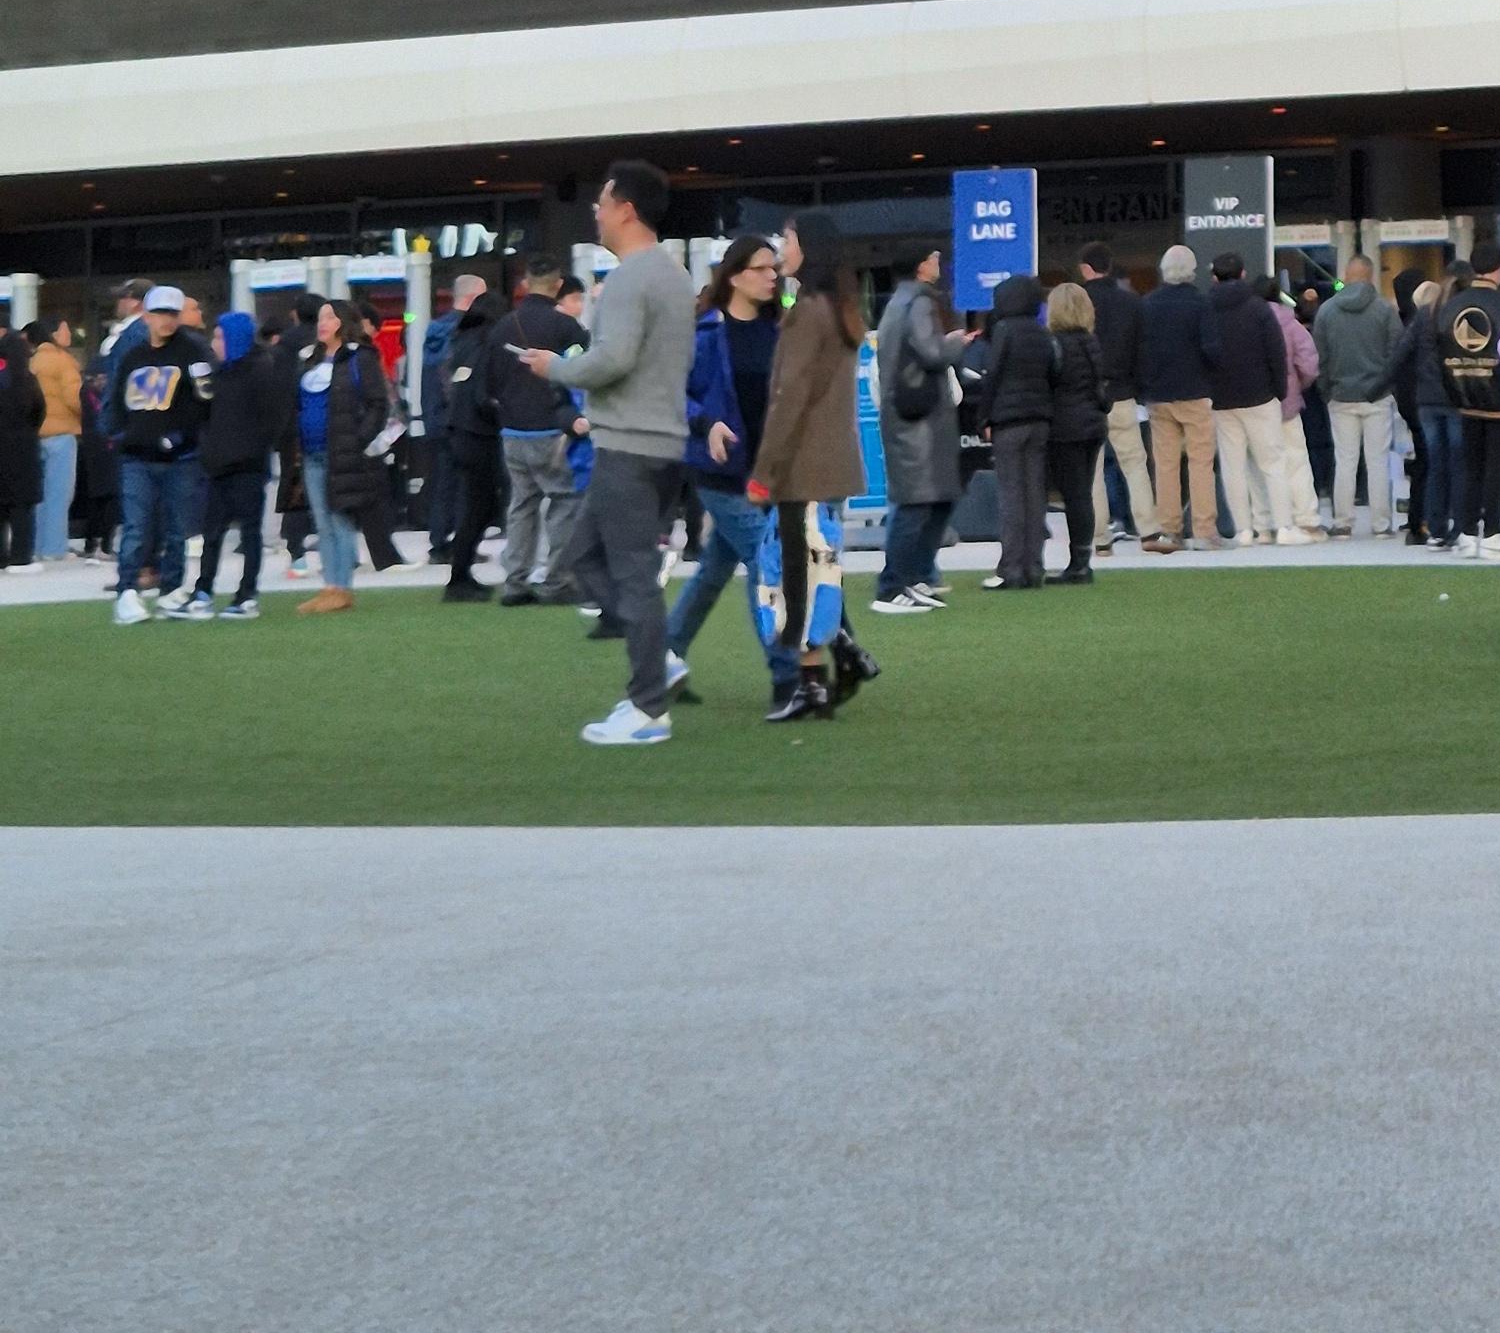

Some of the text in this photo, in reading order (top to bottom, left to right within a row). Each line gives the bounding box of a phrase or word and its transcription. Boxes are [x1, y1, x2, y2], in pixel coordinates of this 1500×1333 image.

[976, 201, 1012, 218] BAG
[1213, 197, 1240, 211] VIP
[1188, 213, 1266, 230] ENTRANCE
[971, 222, 1018, 241] LANE
